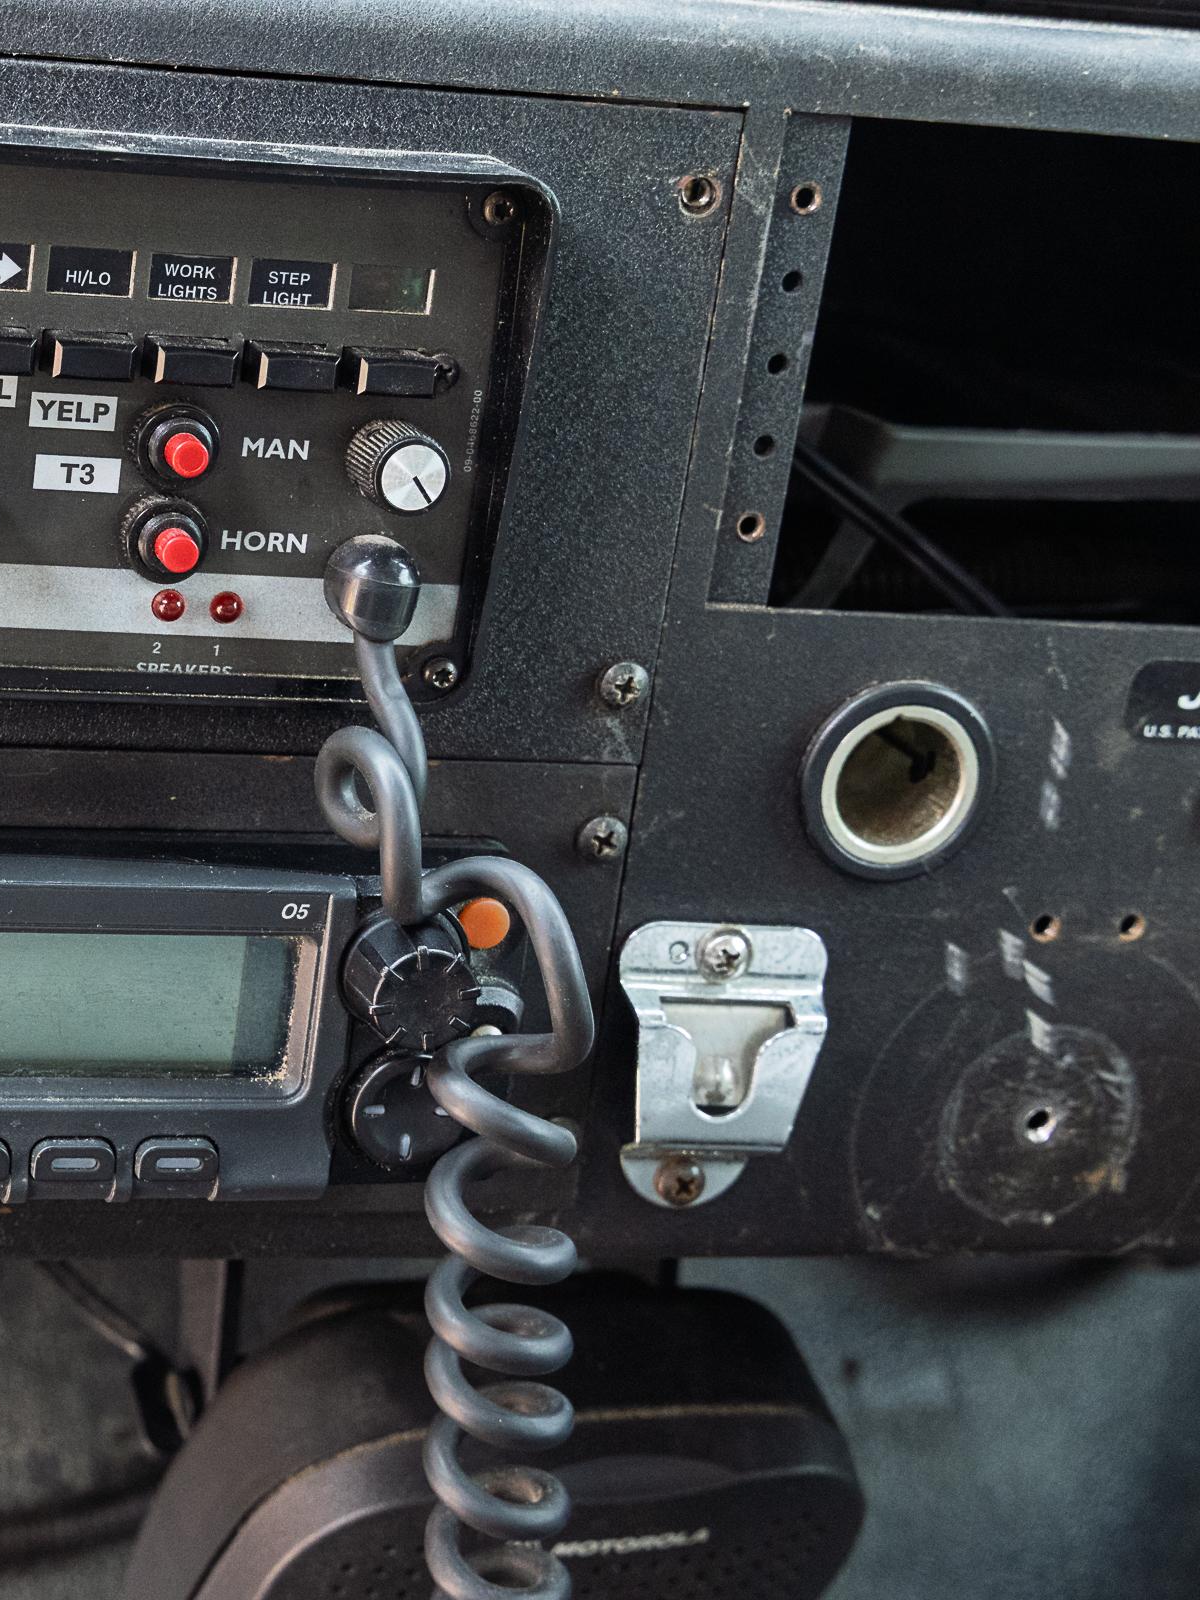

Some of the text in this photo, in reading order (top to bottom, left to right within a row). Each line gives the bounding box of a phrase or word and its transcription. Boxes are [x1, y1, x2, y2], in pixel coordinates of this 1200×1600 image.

[65, 269, 111, 287] HI/LO
[164, 263, 216, 280] WORK
[268, 270, 311, 286] STEP
[157, 283, 218, 300] LIGHTS
[262, 290, 312, 306] LIGHT
[36, 399, 111, 424] YELP
[241, 436, 310, 461] MAN
[59, 462, 95, 486] T3
[220, 529, 309, 554] HORN
[152, 641, 220, 657] 2 1
